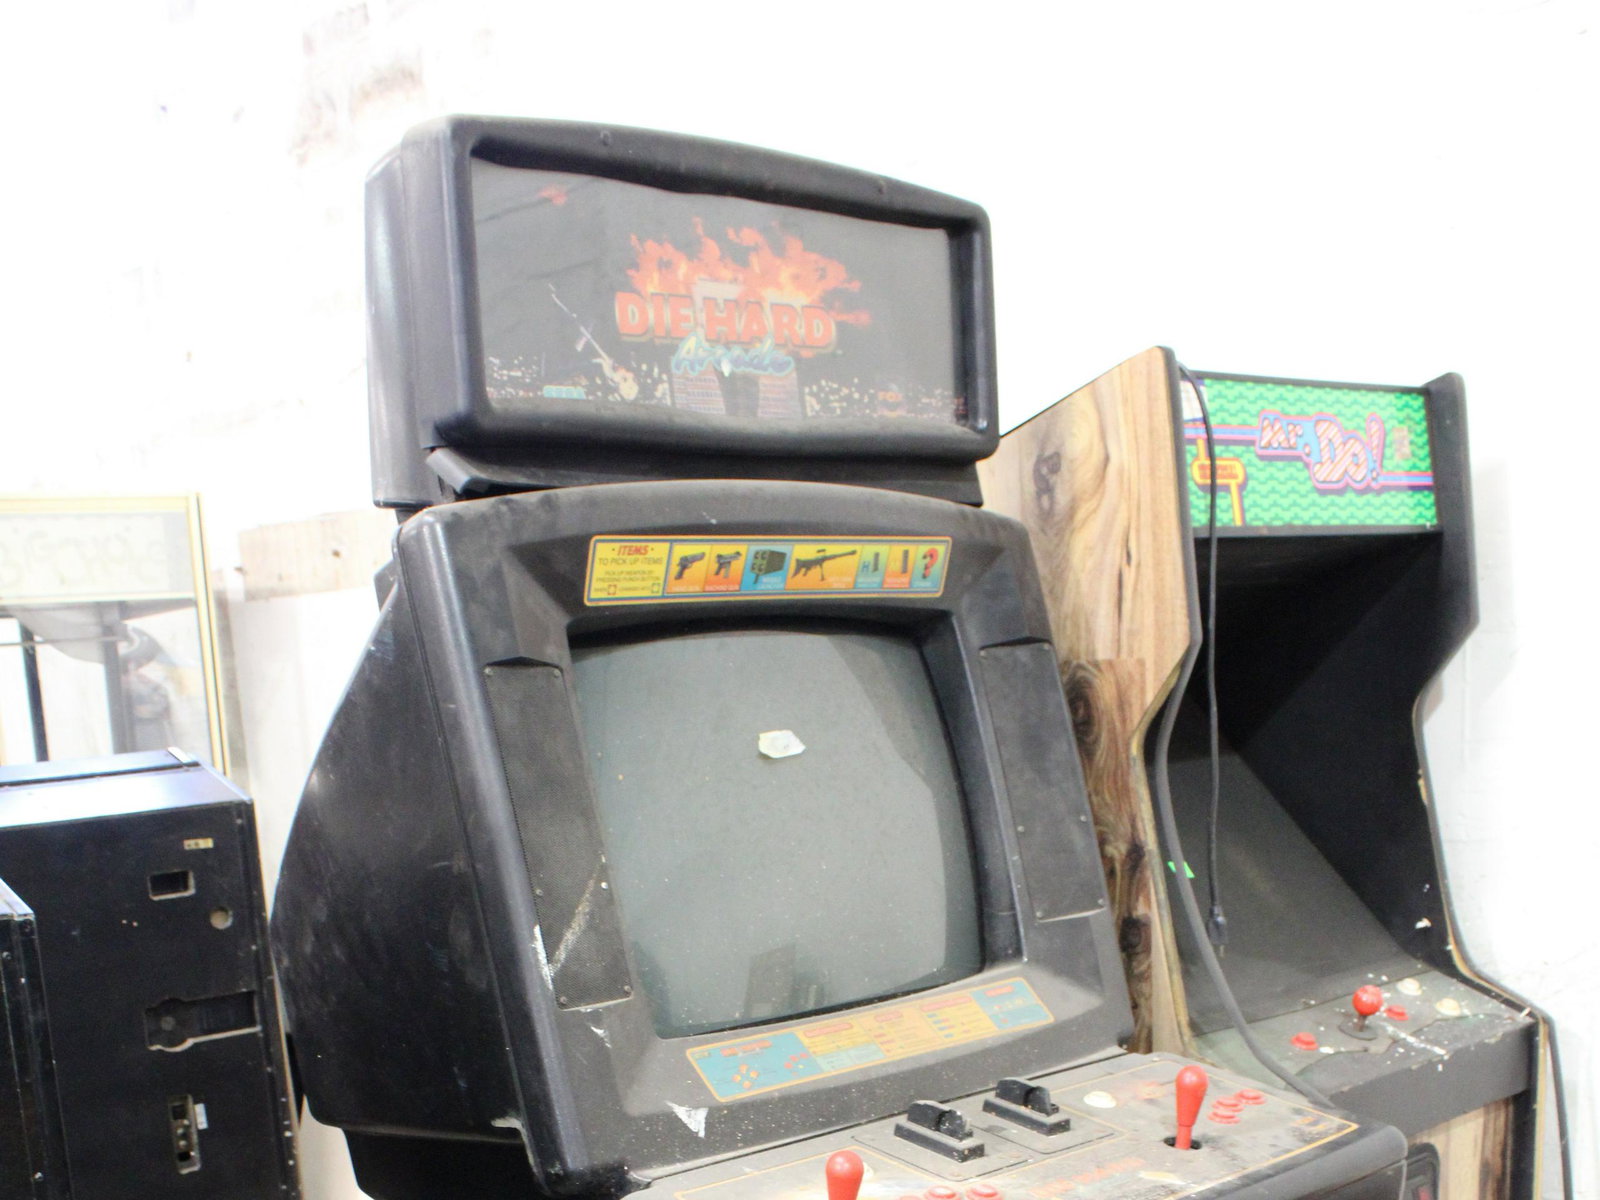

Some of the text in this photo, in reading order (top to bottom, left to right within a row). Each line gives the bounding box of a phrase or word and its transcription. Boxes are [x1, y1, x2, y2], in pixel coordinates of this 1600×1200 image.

[615, 291, 835, 350] DIE HARD
[671, 333, 794, 376] Arcade
[543, 384, 586, 400] SEGA
[1259, 417, 1312, 457] Mr.
[1313, 418, 1382, 483] Do!
[617, 545, 650, 556] ITEMS
